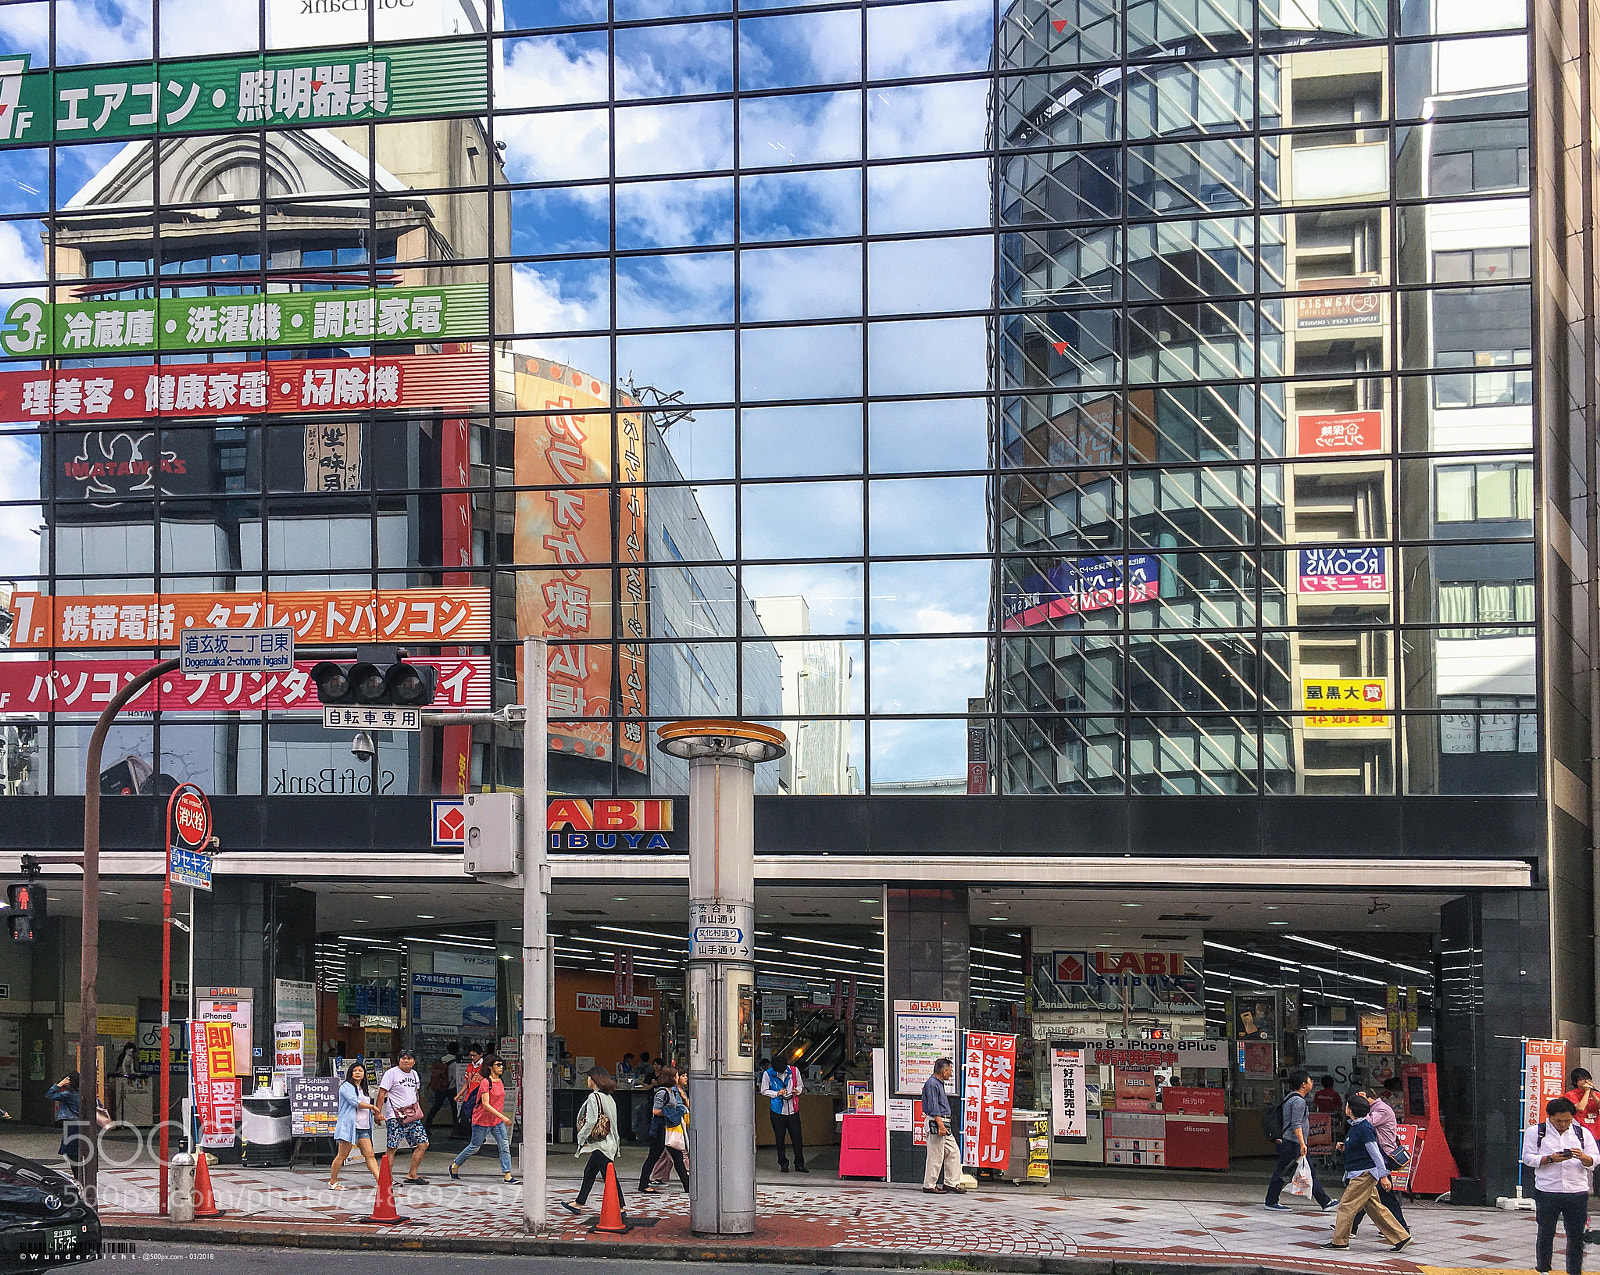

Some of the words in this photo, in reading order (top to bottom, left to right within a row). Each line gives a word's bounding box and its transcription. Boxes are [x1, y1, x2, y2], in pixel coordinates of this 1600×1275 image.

[56, 61, 389, 133] エアコン・照明器具
[62, 296, 443, 349] 冷蔵庫・洗濯機・調理家電
[22, 365, 400, 416] 理美容・健康家電・掃除機
[15, 596, 45, 643] 1F
[184, 633, 290, 655] 道玄坂二丁目東
[184, 656, 226, 669] Dogenzaka
[226, 656, 261, 667] 2-chome
[262, 654, 290, 668] higashi
[329, 709, 416, 727] 自転車専用
[179, 805, 204, 832] 消火栓
[547, 799, 673, 831] ABI
[551, 833, 671, 849] IBUYA
[181, 851, 212, 873] セキネ
[698, 903, 736, 914] 渋谷駅
[699, 914, 736, 924] 青山通り
[699, 929, 737, 938] 文化村通り
[698, 945, 737, 955] 山手通り
[1095, 951, 1185, 976] LABI
[585, 996, 613, 1010] CASHIER
[920, 1001, 942, 1009] LABI
[1038, 1001, 1088, 1010] Panasonic
[1097, 1002, 1136, 1010] SONY
[202, 1012, 232, 1020] iPhone8
[608, 1012, 630, 1025] iPad
[969, 1035, 1016, 1049] ヤマダ
[1127, 1041, 1174, 1051] iPhone
[1177, 1041, 1217, 1052] 8Plus
[1531, 1044, 1563, 1054] ヤマダ
[208, 1026, 233, 1074] 即日
[1095, 1051, 1178, 1066] 好評発売中
[295, 1083, 330, 1093] iPhone
[211, 1081, 236, 1129] 翌日
[965, 1051, 981, 1165] 全店一斉開催中!!
[981, 1054, 1012, 1163] 決算セール
[1184, 1125, 1211, 1133] docomo
